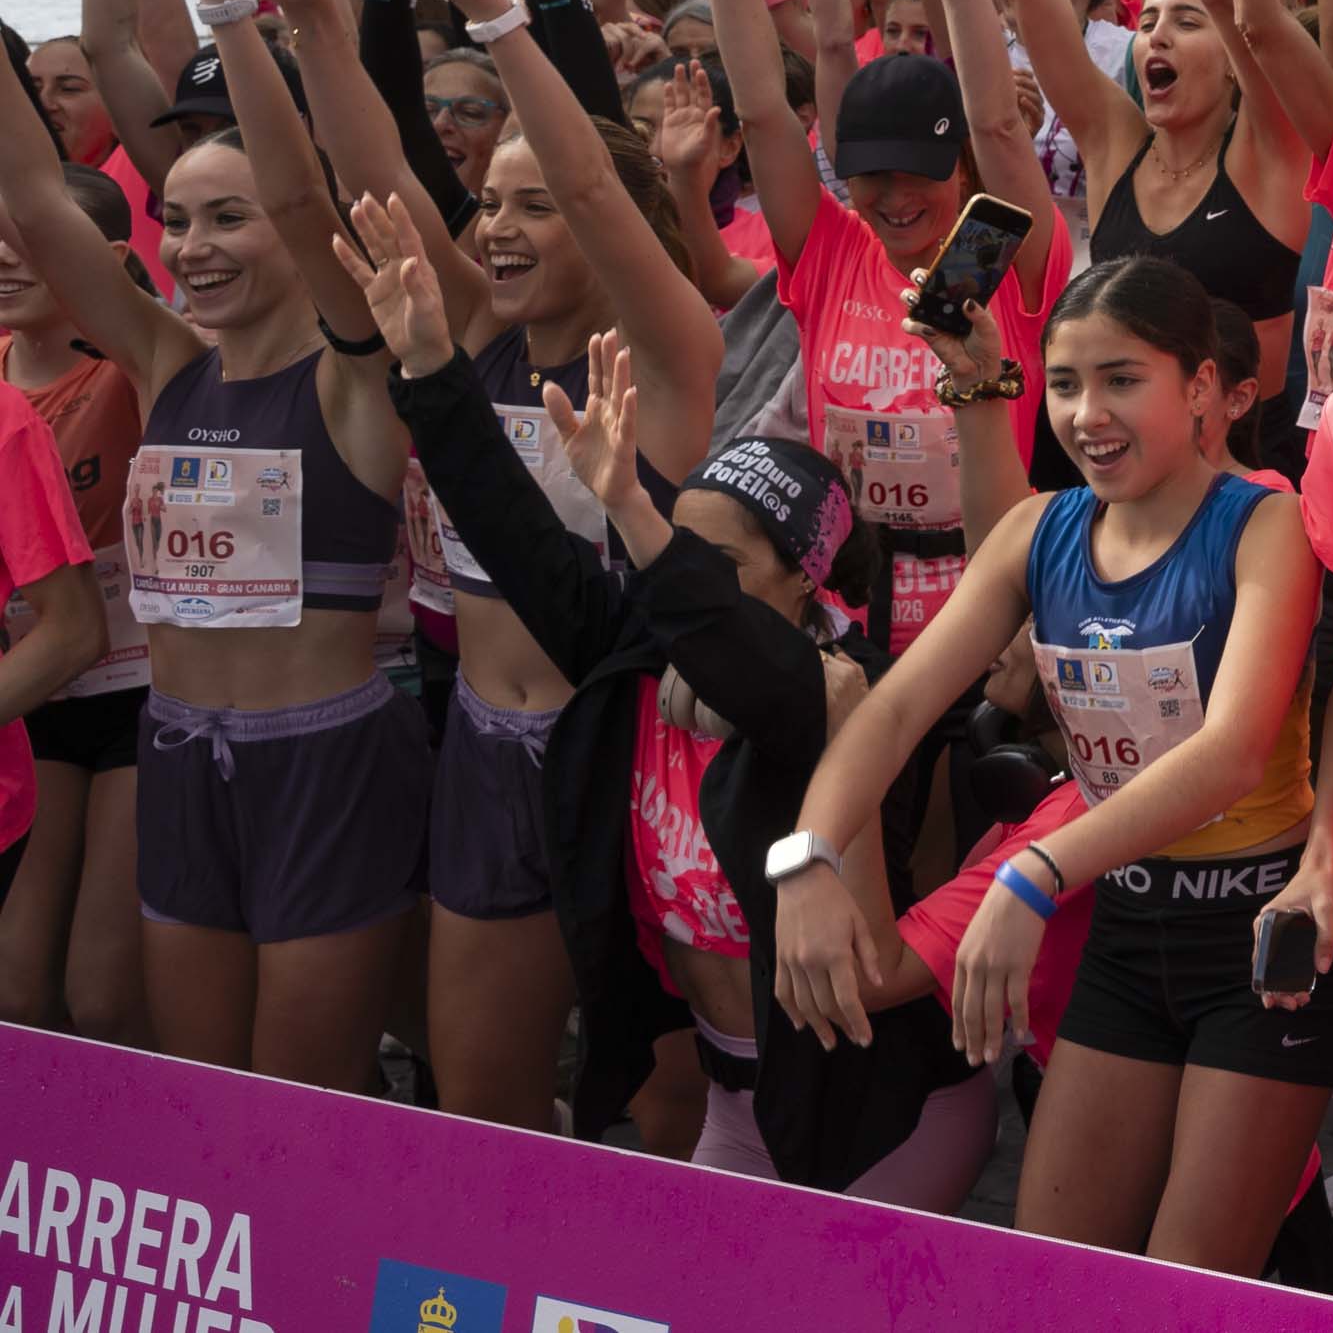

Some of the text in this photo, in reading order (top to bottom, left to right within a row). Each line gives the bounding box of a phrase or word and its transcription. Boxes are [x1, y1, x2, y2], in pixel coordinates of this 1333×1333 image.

[829, 342, 945, 389] CARRER
[188, 428, 240, 442] OYSHO
[718, 449, 802, 498] DoyDuro
[703, 462, 791, 522] PorEll@s
[868, 481, 929, 507] 016
[167, 529, 235, 559] 016
[184, 565, 215, 577] 1907
[217, 582, 243, 593] GRAN
[246, 582, 291, 593] CANARIA
[891, 598, 924, 623] 026
[1073, 733, 1141, 767] 016
[1102, 771, 1119, 784] 89
[1105, 859, 1288, 899] RO NIKE
